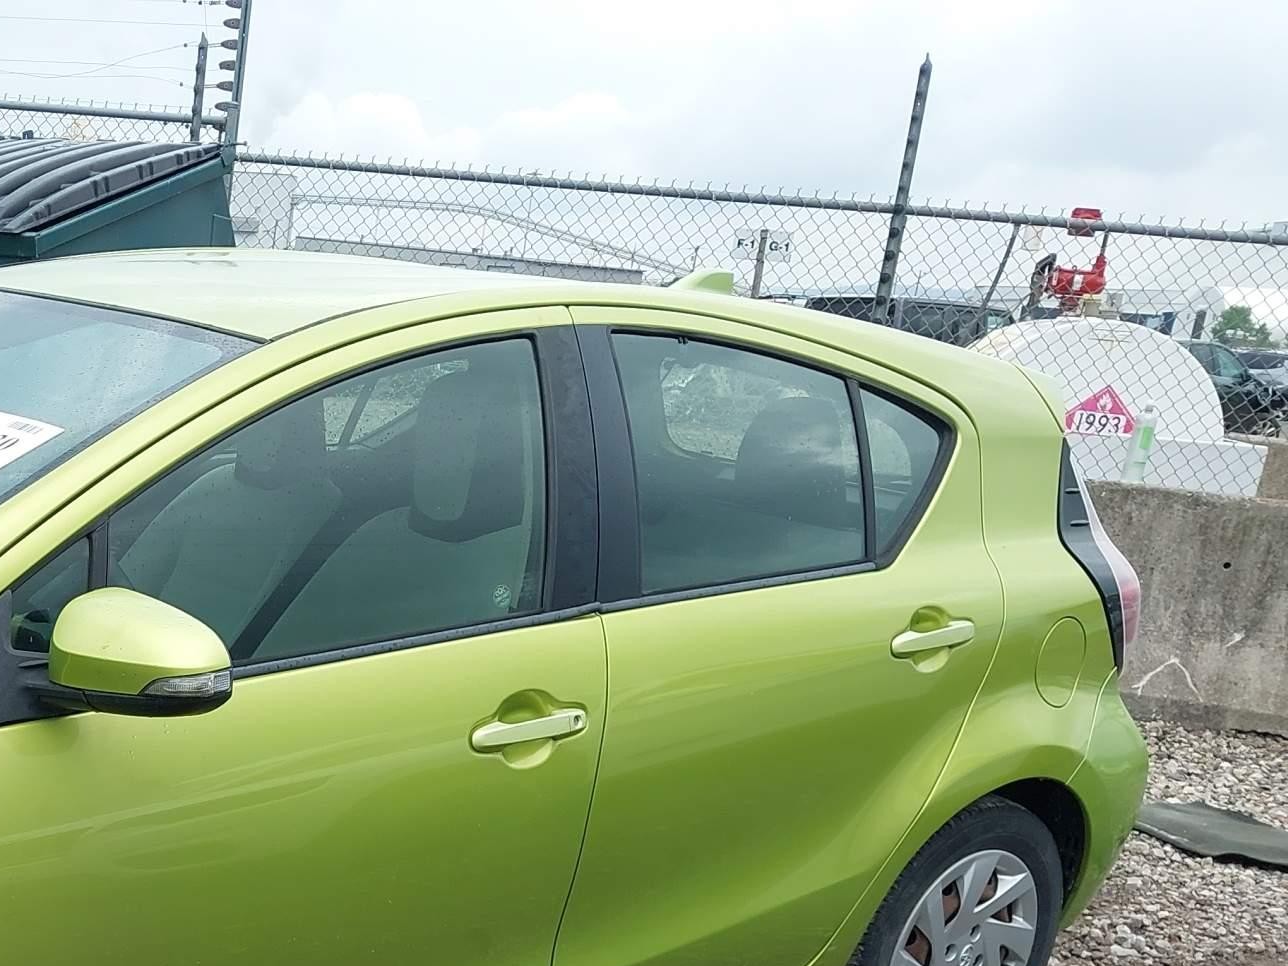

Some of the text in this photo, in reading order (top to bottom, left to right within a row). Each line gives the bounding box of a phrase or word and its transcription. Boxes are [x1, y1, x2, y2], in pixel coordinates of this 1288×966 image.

[737, 238, 755, 249] F-1
[769, 240, 790, 252] G-1
[1076, 412, 1121, 434] 1993
